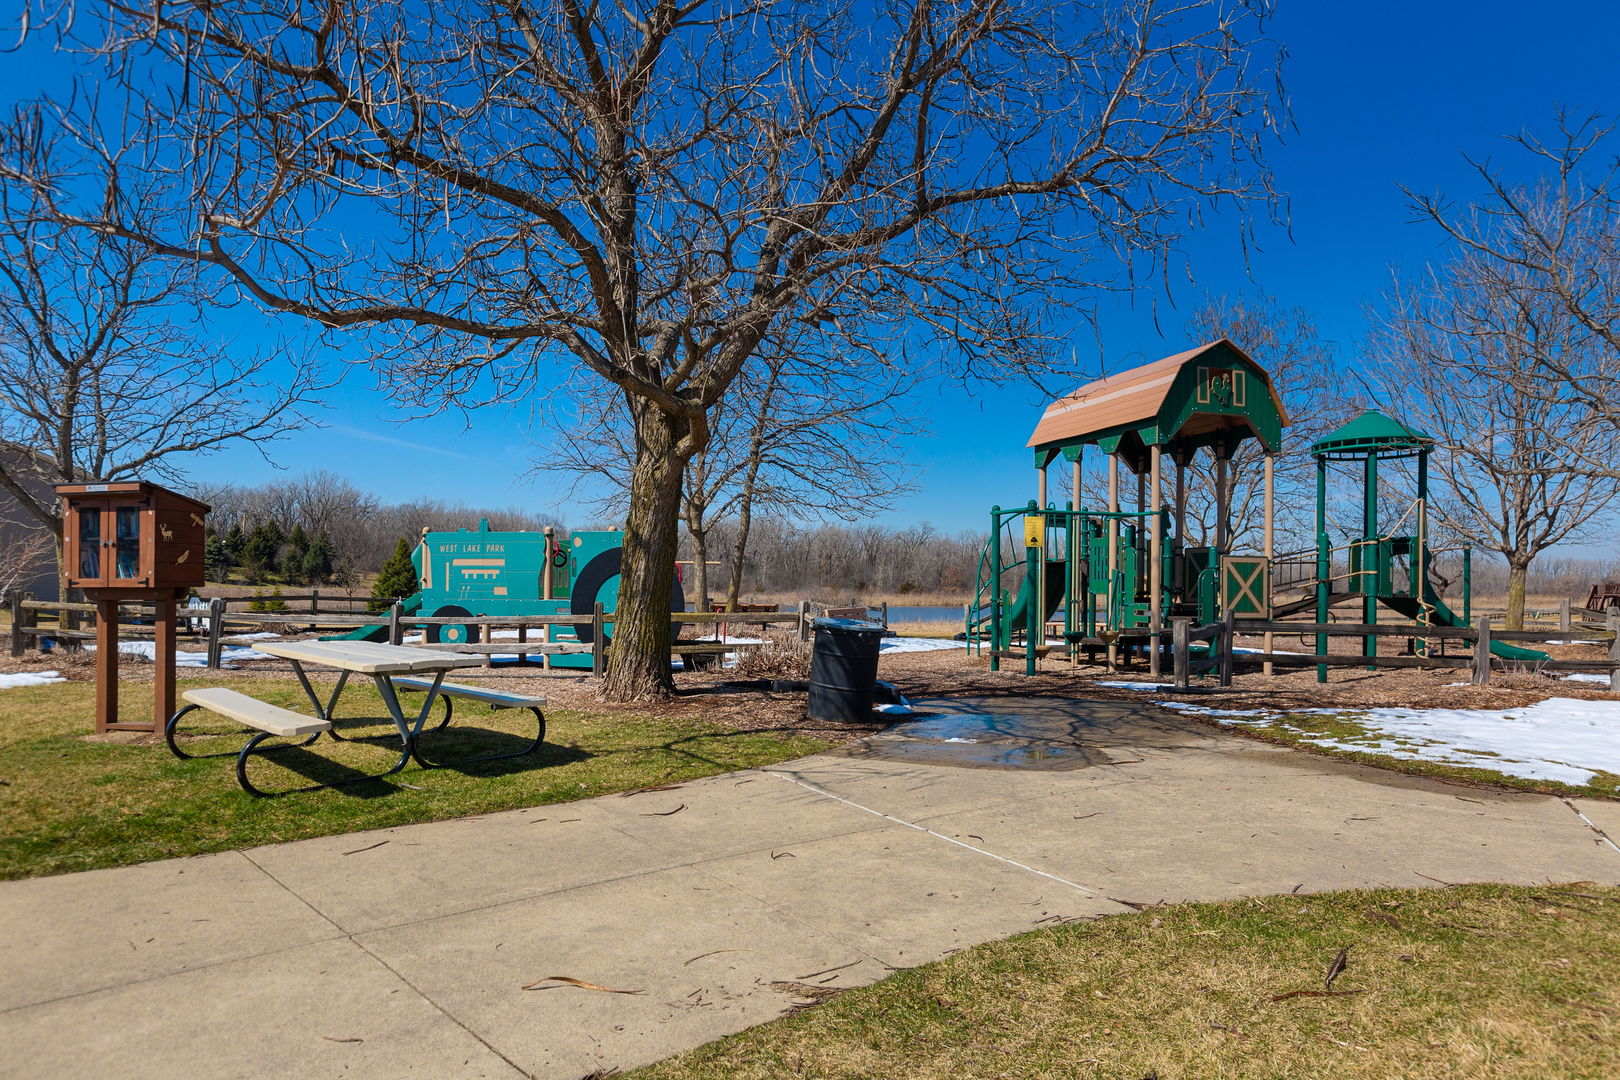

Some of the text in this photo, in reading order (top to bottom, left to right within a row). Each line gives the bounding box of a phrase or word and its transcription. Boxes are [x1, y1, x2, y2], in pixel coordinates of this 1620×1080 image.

[440, 544, 505, 553] WEST LAKE PARK
